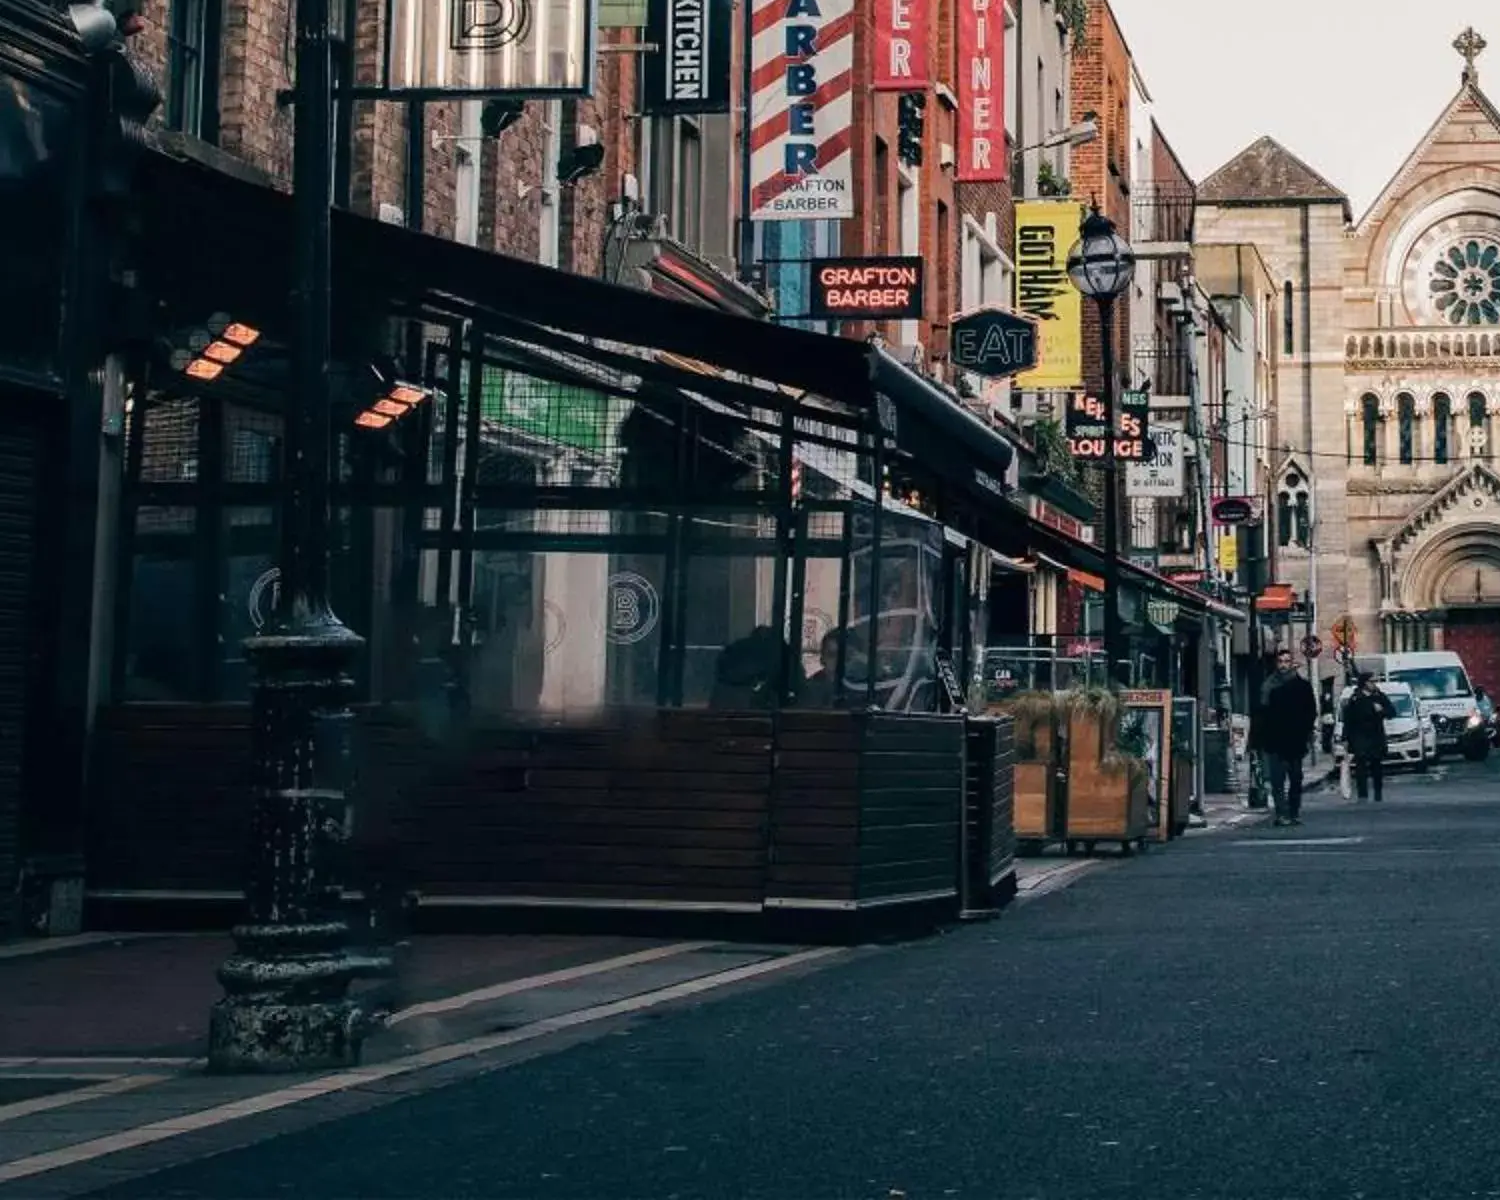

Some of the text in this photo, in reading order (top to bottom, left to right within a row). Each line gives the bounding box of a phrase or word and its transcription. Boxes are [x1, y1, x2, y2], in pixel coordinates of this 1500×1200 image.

[774, 197, 839, 210] BARBER
[820, 267, 917, 286] GRAFTON
[826, 288, 910, 308] BARBER
[955, 323, 1031, 365] EAT
[1070, 439, 1144, 458] LOUGE
